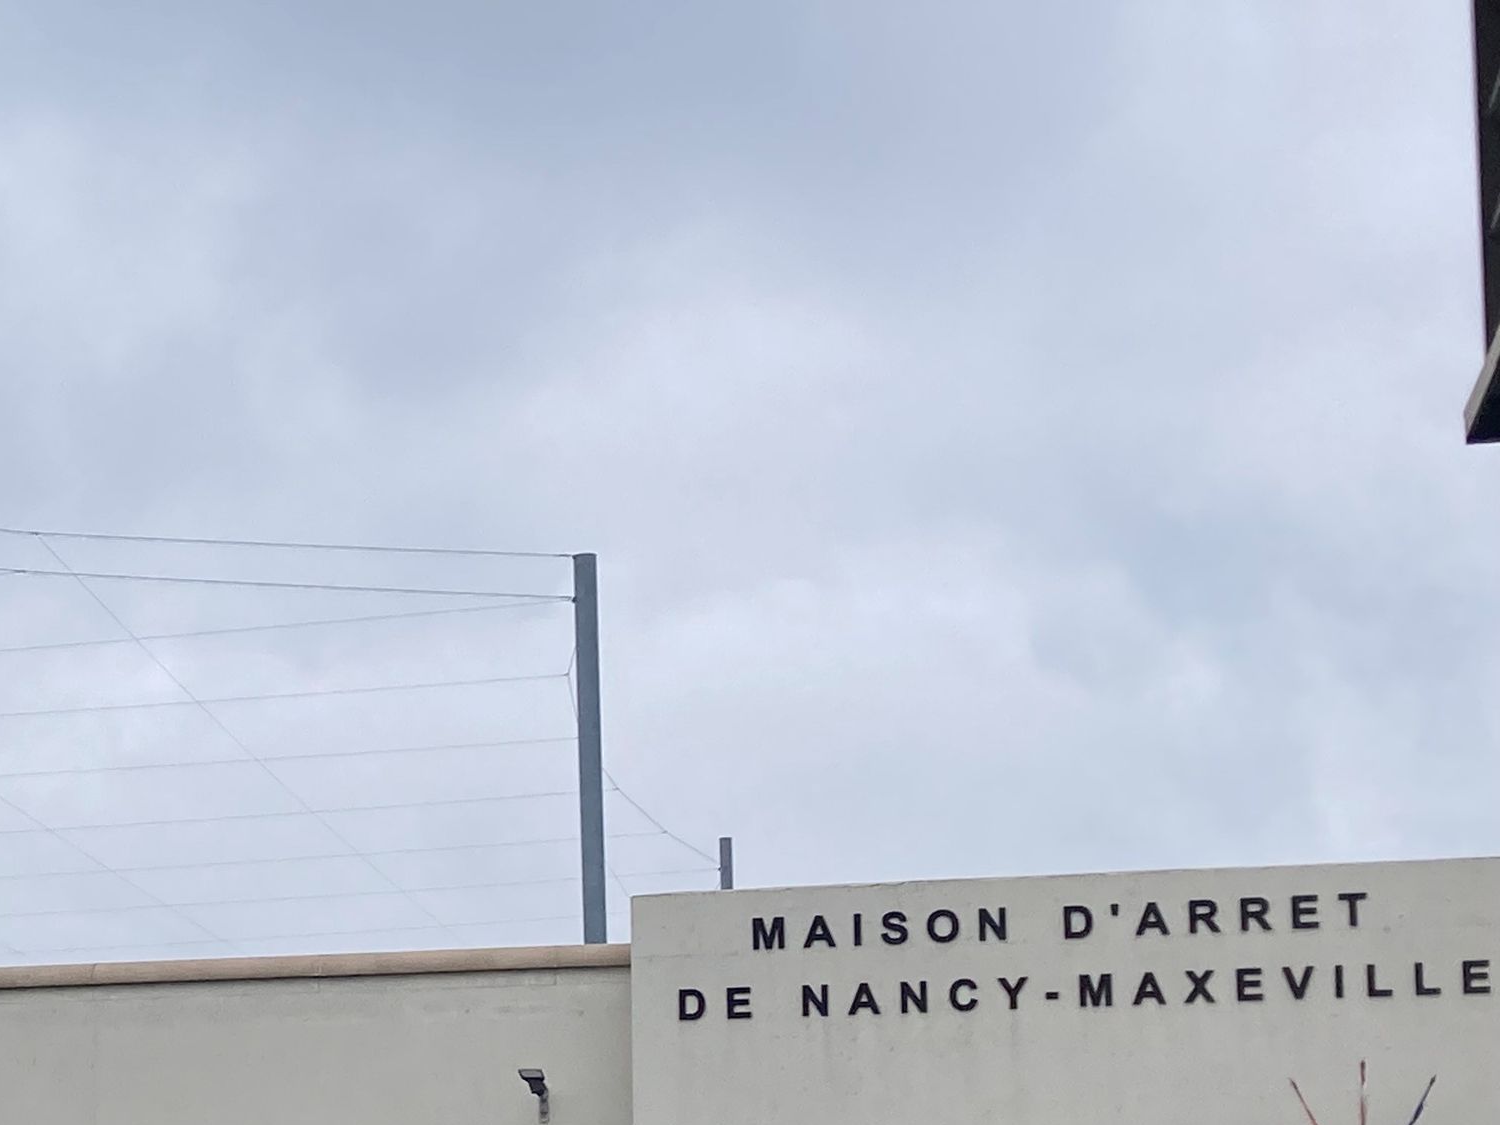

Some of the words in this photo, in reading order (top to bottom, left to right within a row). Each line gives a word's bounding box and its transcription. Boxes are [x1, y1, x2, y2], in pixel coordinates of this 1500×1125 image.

[751, 906, 1008, 951] MAISON
[1062, 892, 1369, 941] D'ARRET
[678, 986, 754, 1022] DE
[801, 959, 1491, 1018] NANCY-MAXEVILLE
